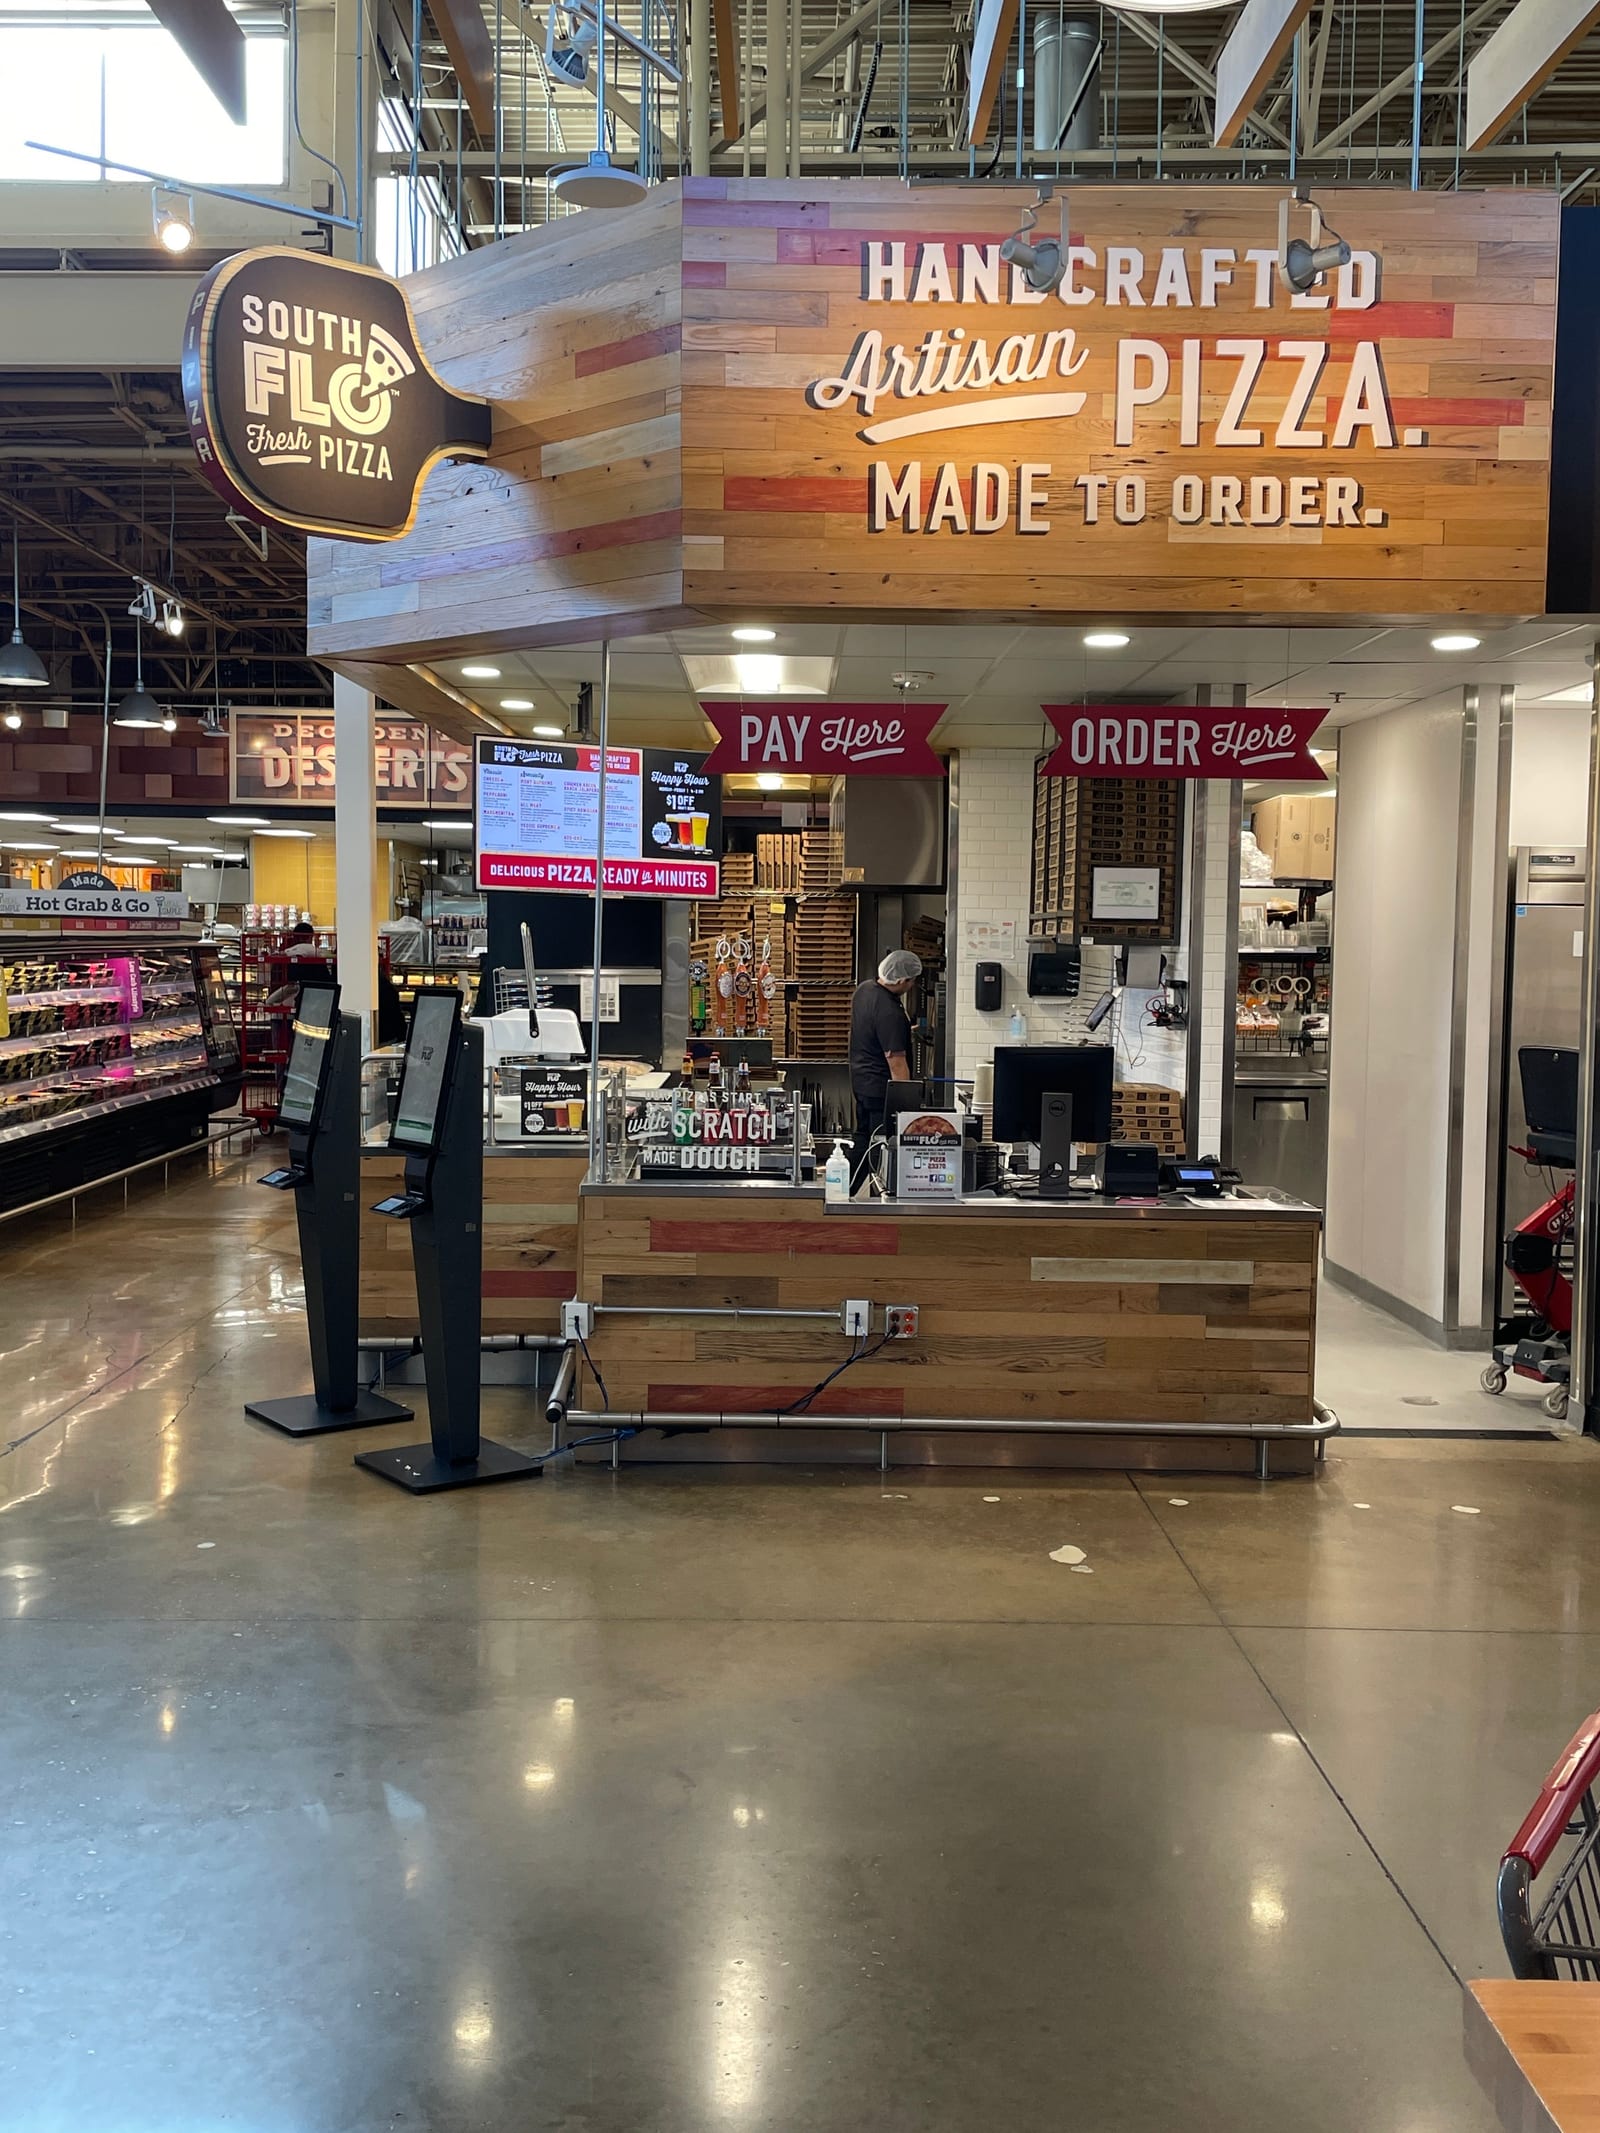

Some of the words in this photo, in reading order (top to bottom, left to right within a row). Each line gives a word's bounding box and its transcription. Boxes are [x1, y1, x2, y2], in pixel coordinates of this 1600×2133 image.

[241, 293, 363, 358] SOUTH
[243, 339, 394, 436] FLO
[812, 328, 1090, 416] Artisan
[1114, 338, 1431, 449] PIZZA.
[246, 422, 313, 455] Fresh
[318, 433, 394, 482] PIZZA
[873, 460, 1052, 534] MADE
[1076, 474, 1147, 525] TO
[1171, 474, 1385, 528] ORDER.
[740, 715, 811, 762] PAY
[820, 716, 905, 756] Here
[1071, 717, 1201, 766] ORDER
[1211, 720, 1297, 760] Here
[540, 751, 563, 764] PIZZA
[651, 770, 684, 787] Happy
[684, 773, 710, 786] Hour
[666, 794, 677, 810] $1
[677, 794, 695, 806] OFF
[490, 863, 545, 878] DELICIOUS
[642, 870, 652, 883] in
[654, 869, 708, 889] MINUTES
[26, 896, 60, 912] Hot
[64, 897, 108, 913] Grab
[111, 898, 122, 913] &
[125, 898, 150, 913] Go
[525, 1081, 556, 1094] Happy
[556, 1081, 582, 1092] Hour
[722, 1091, 762, 1103] START
[627, 1111, 669, 1134] with
[672, 1110, 777, 1141] SCRATCH
[919, 1135, 939, 1145] FLO
[643, 1150, 676, 1165] MADE
[680, 1146, 760, 1171] DOUGH
